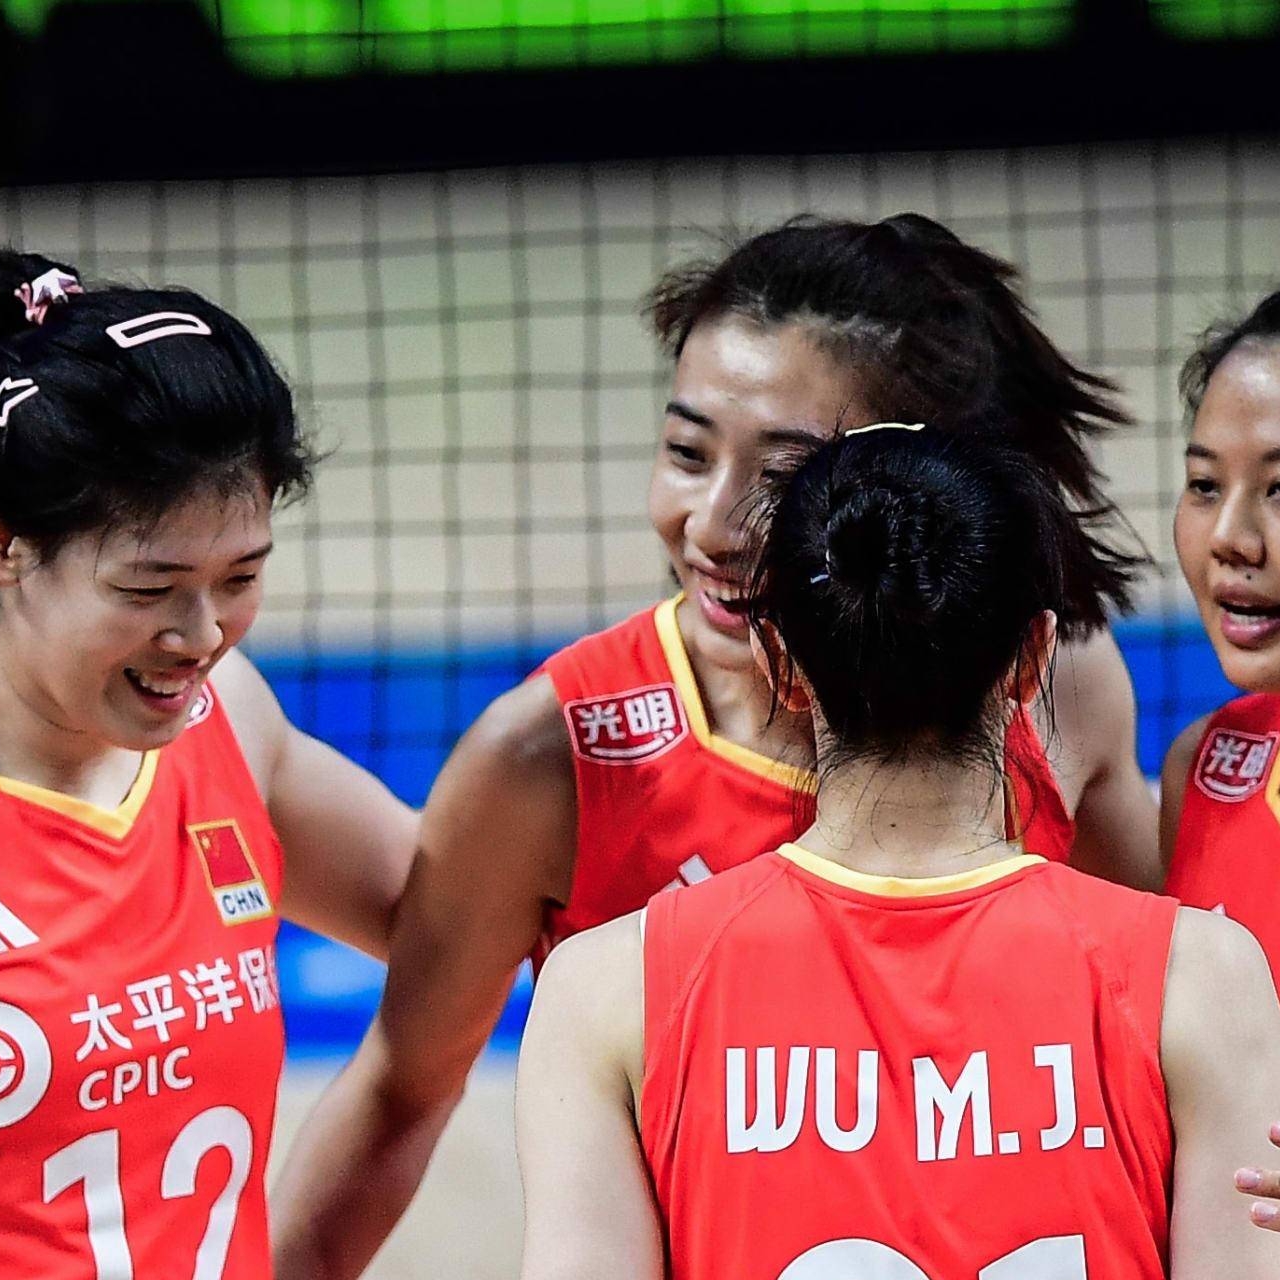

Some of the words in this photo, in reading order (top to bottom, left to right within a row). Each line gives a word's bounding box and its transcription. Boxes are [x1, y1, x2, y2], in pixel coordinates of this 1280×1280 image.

[576, 690, 676, 744] 光明
[1205, 734, 1272, 780] 光明
[222, 888, 264, 916] CHN
[78, 1046, 193, 1111] CPIC
[725, 1045, 879, 1154] WU
[911, 1042, 1106, 1162] M.J.
